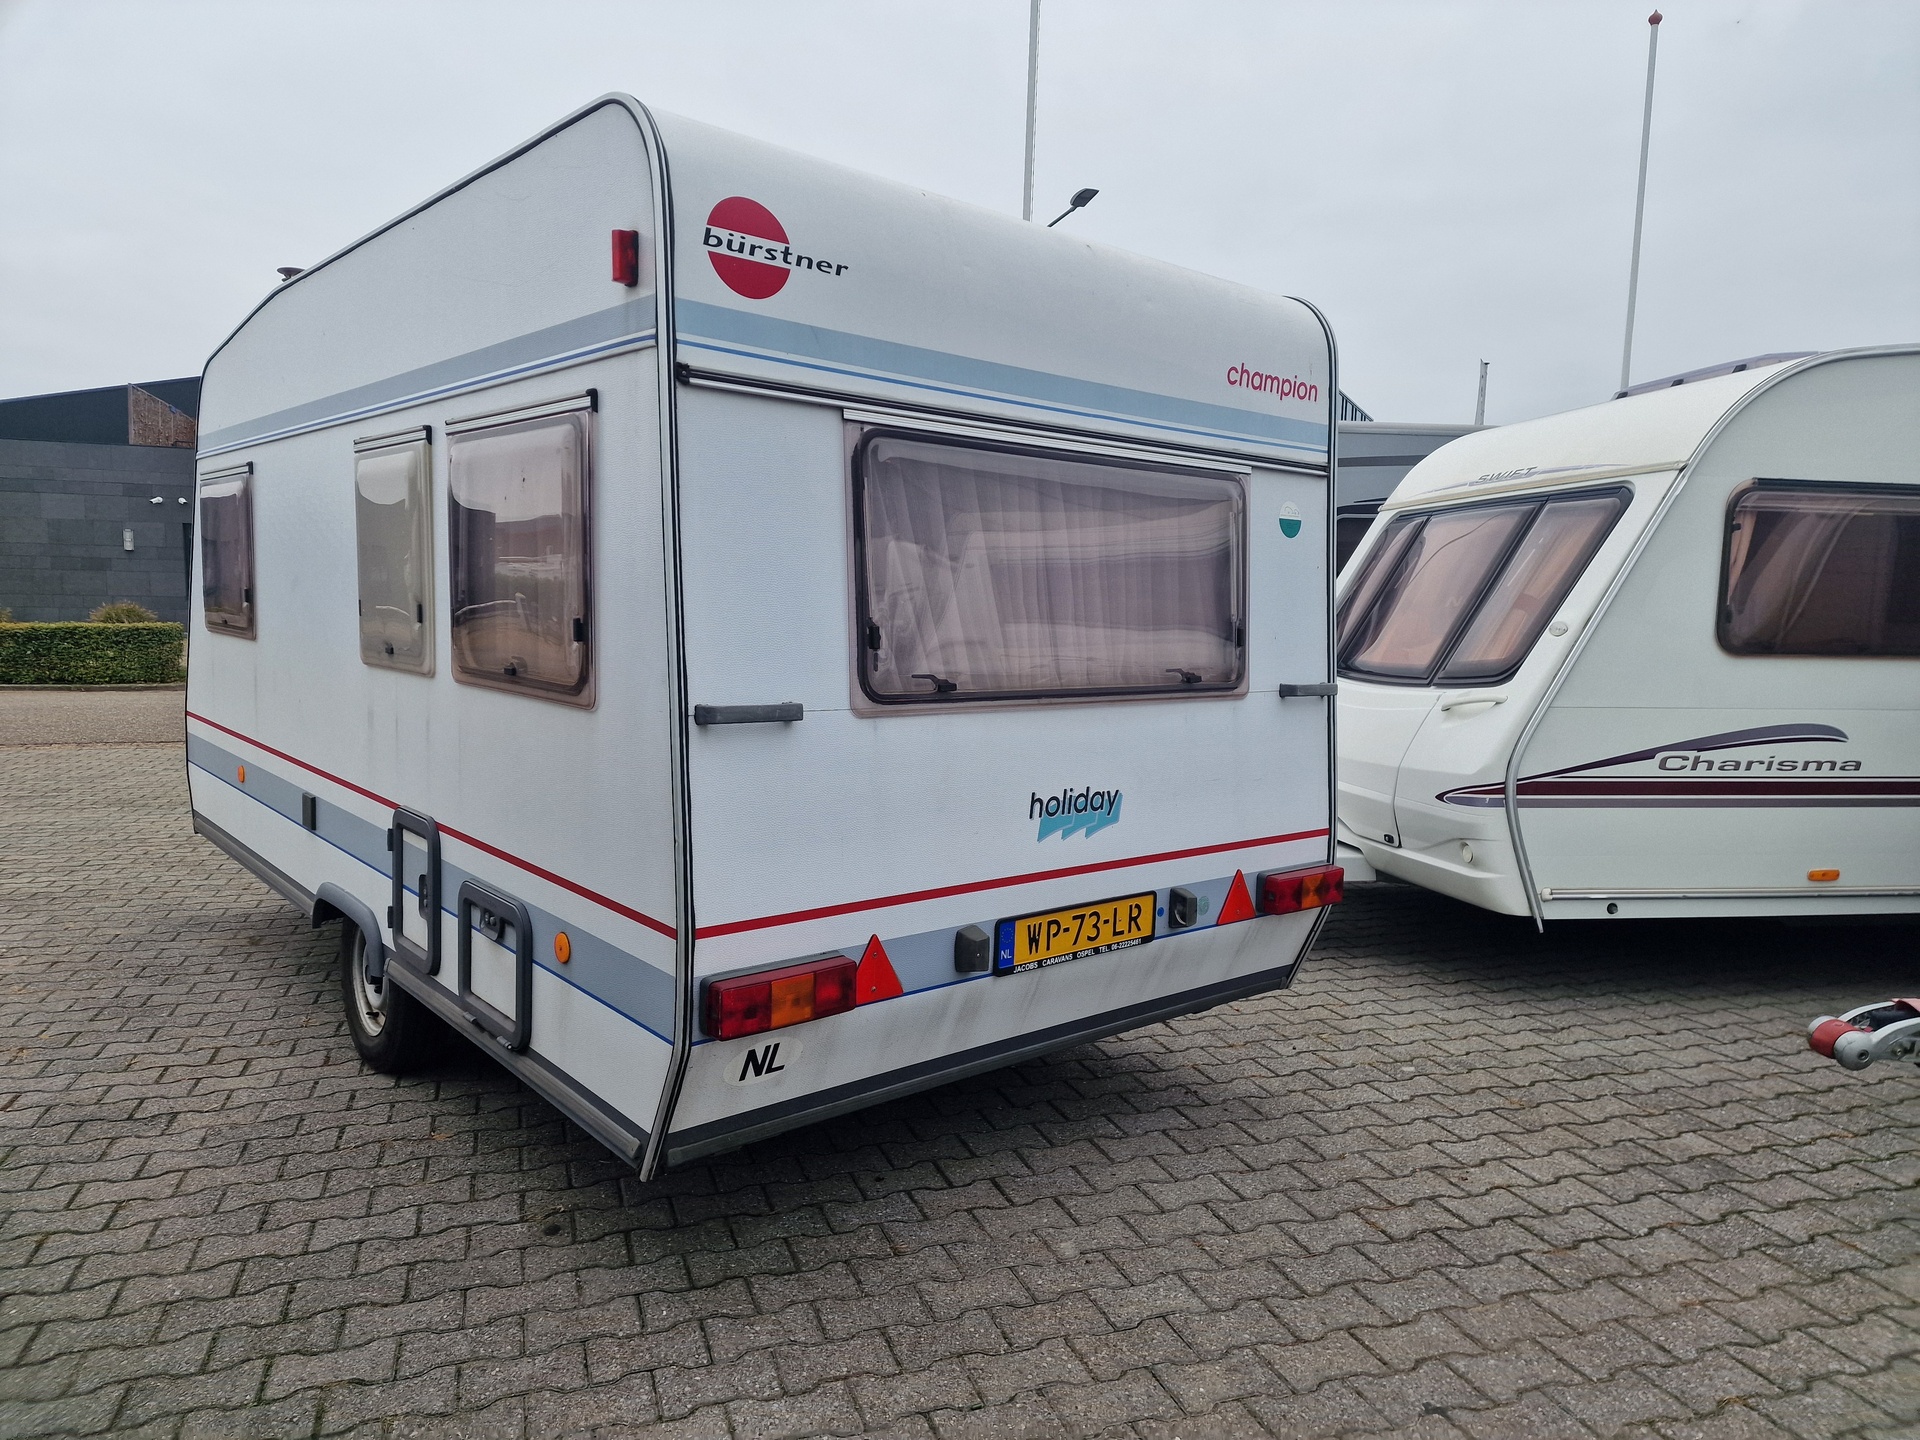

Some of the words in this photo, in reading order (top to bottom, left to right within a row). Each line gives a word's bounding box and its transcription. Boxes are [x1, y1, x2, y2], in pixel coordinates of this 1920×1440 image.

[702, 226, 849, 277] bürstner
[1226, 362, 1318, 403] champion
[1475, 465, 1538, 485] SWIFT
[1657, 754, 1863, 772] Charisma
[1028, 785, 1120, 820] holiday
[1026, 901, 1143, 956] WP-73-LR
[1000, 949, 1013, 960] NL
[1013, 961, 1039, 974] JACOBS
[1041, 953, 1073, 967] CARAVANS
[1076, 948, 1095, 959] OSPEL
[738, 1042, 786, 1082] NL
